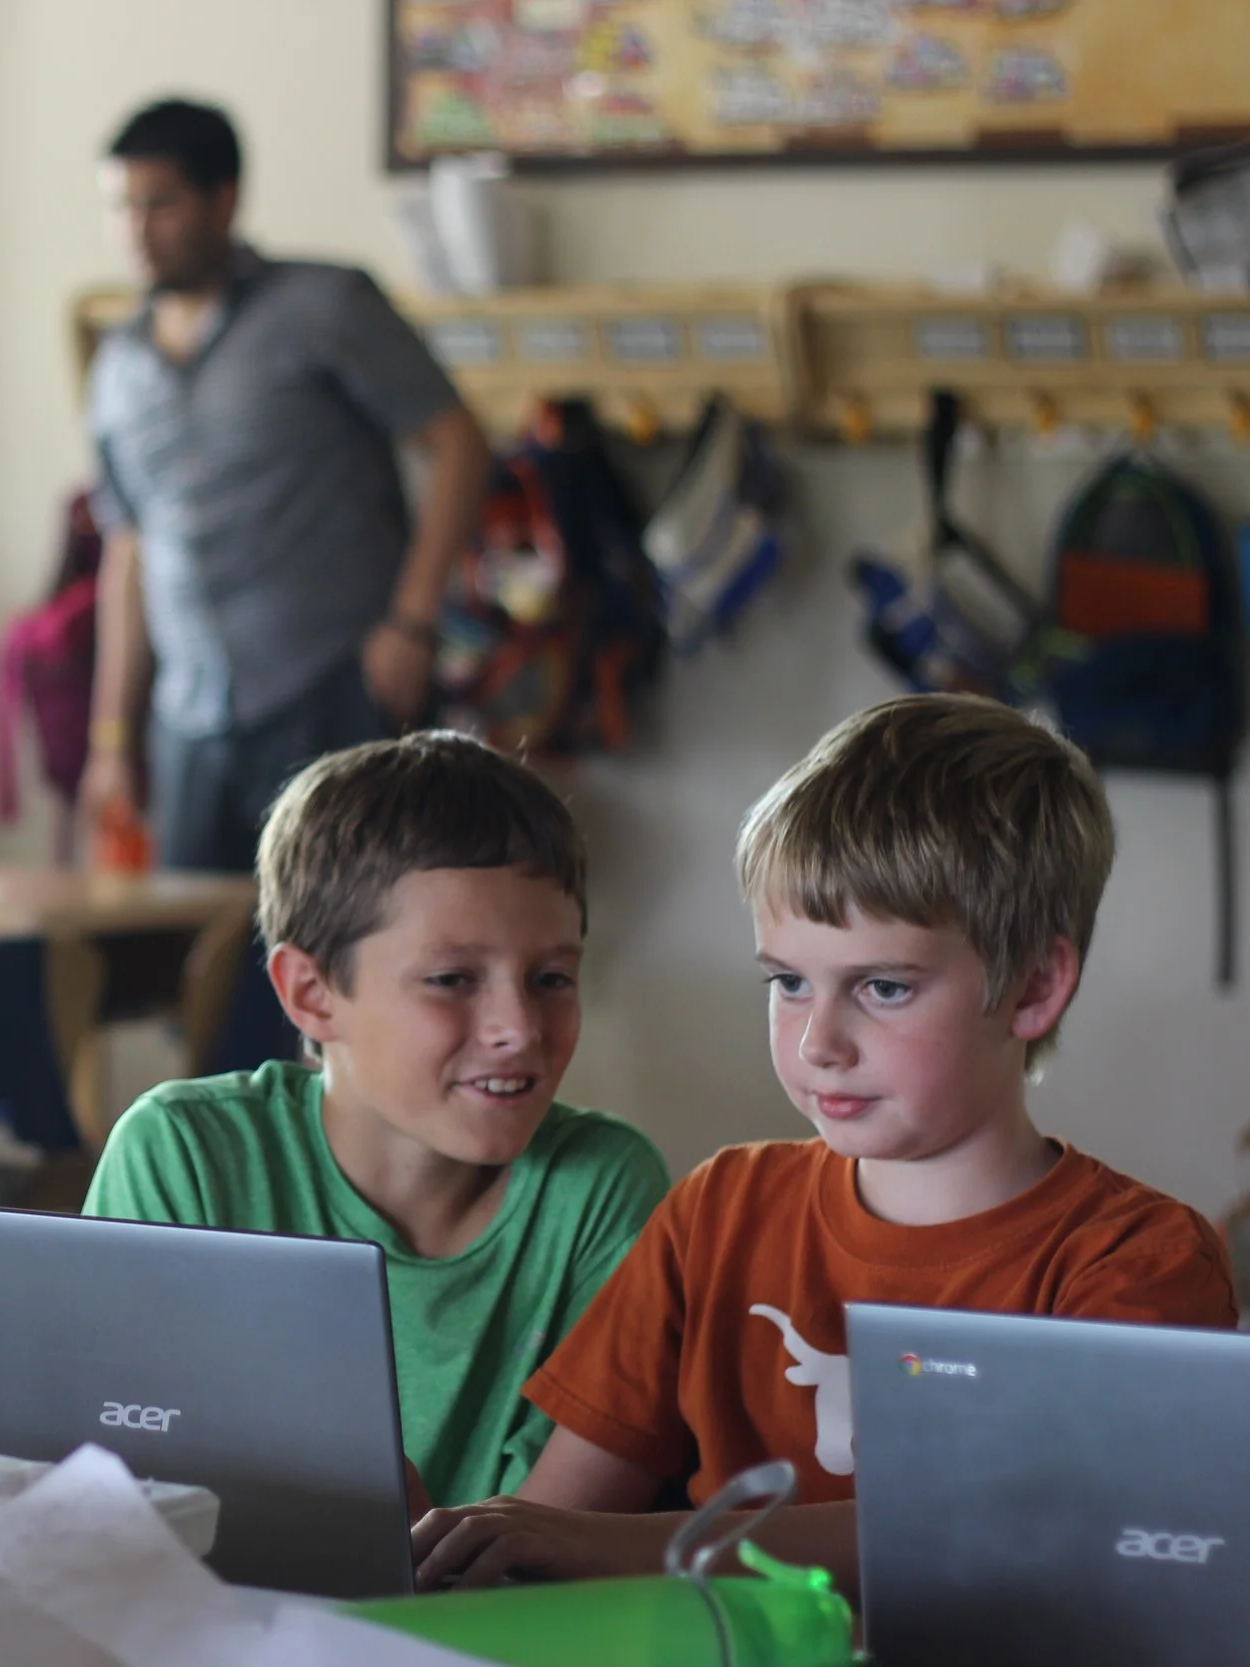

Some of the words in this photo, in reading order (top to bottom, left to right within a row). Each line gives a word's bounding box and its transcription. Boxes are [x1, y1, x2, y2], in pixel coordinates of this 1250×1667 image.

[922, 1358, 977, 1377] chrome
[100, 1401, 181, 1432] acer
[1116, 1527, 1225, 1564] acer
